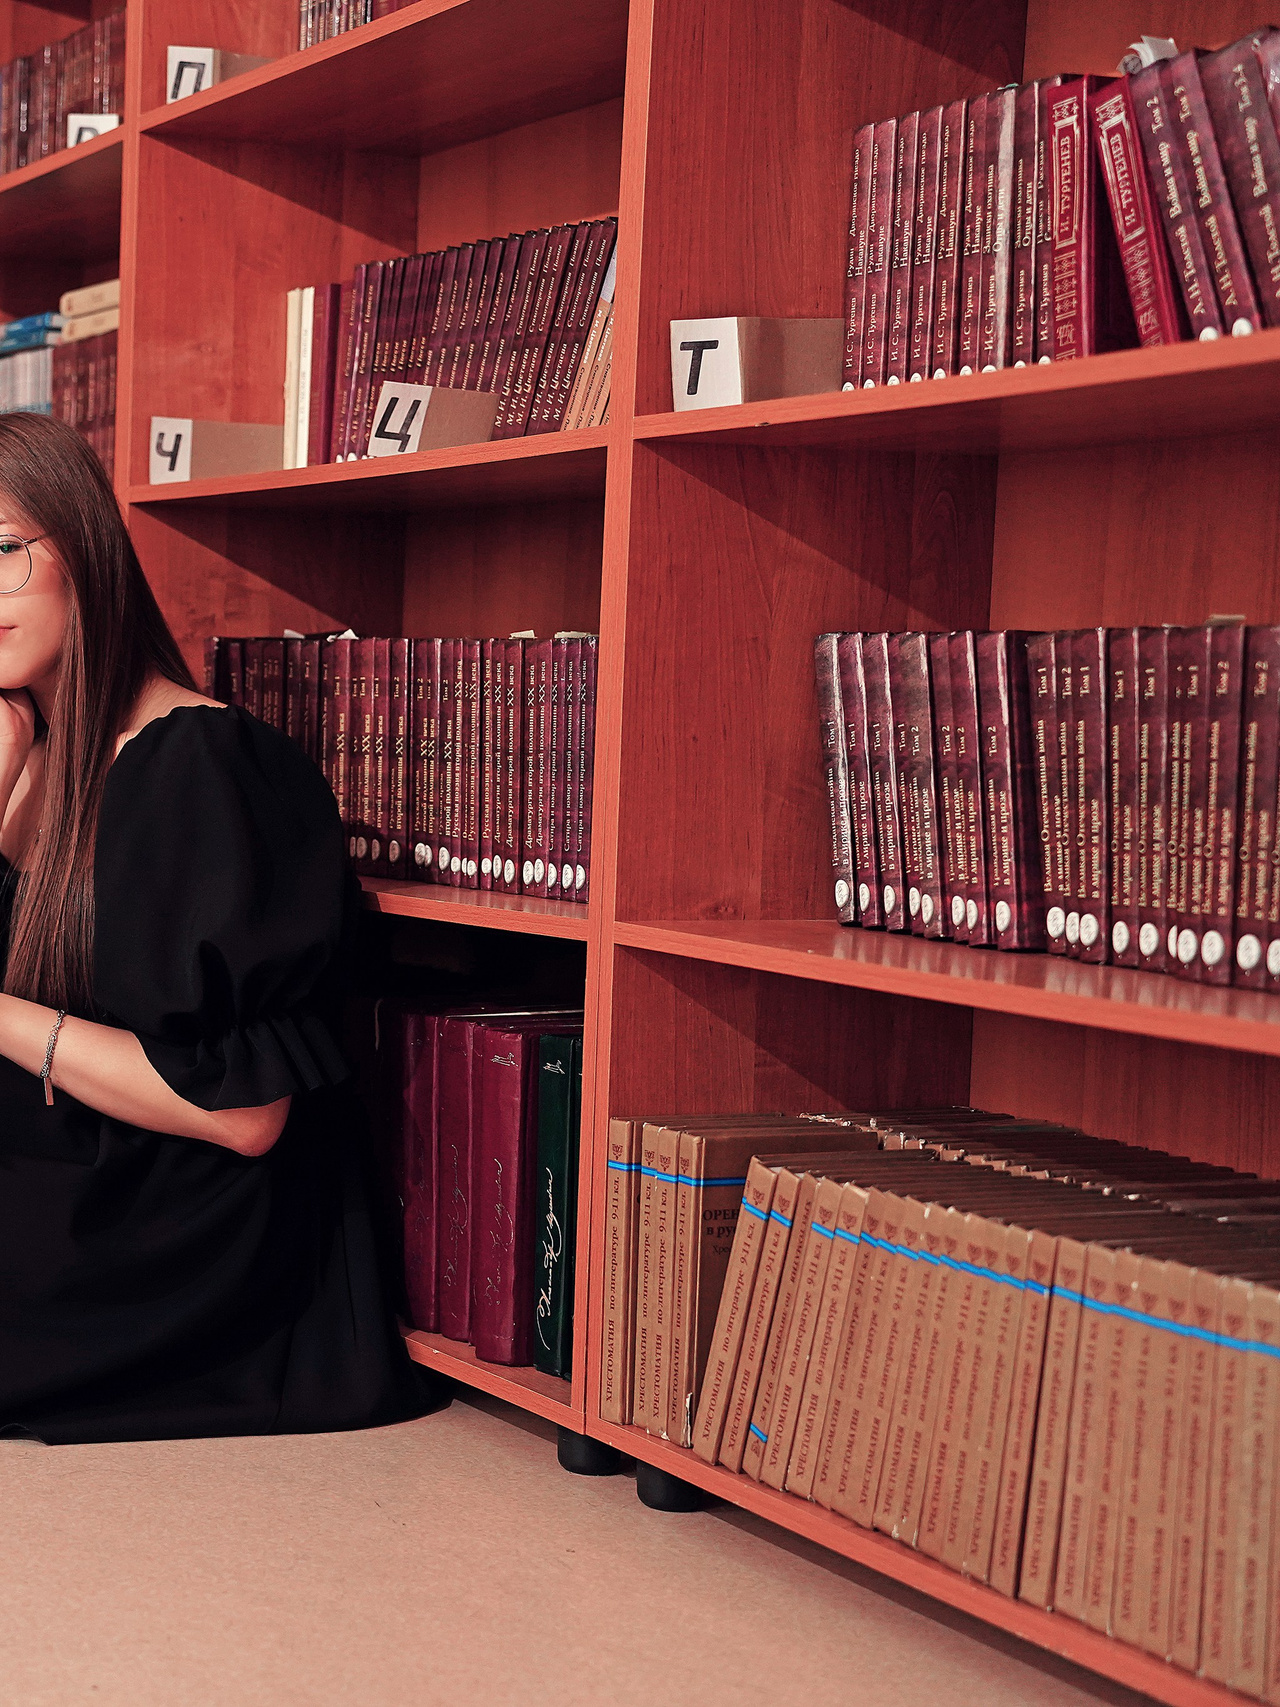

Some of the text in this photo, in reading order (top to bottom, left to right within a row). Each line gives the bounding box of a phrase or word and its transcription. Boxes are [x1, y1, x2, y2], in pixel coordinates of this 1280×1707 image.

[171, 61, 206, 99] П
[1060, 136, 1071, 233] И. ТУРГЕНЕВ
[1110, 133, 1133, 208] ТУРГЕНЕВ
[680, 340, 719, 395] Т
[375, 396, 420, 452] Ц
[606, 1320, 614, 1402] ХРЕСТОМАТИЯ
[639, 1328, 647, 1411] ХРЕСТОМАТИЯ
[653, 1334, 662, 1418] ХРЕСТОМАТИЯ
[702, 1360, 724, 1441] ХРЕСТОМАТИЯ
